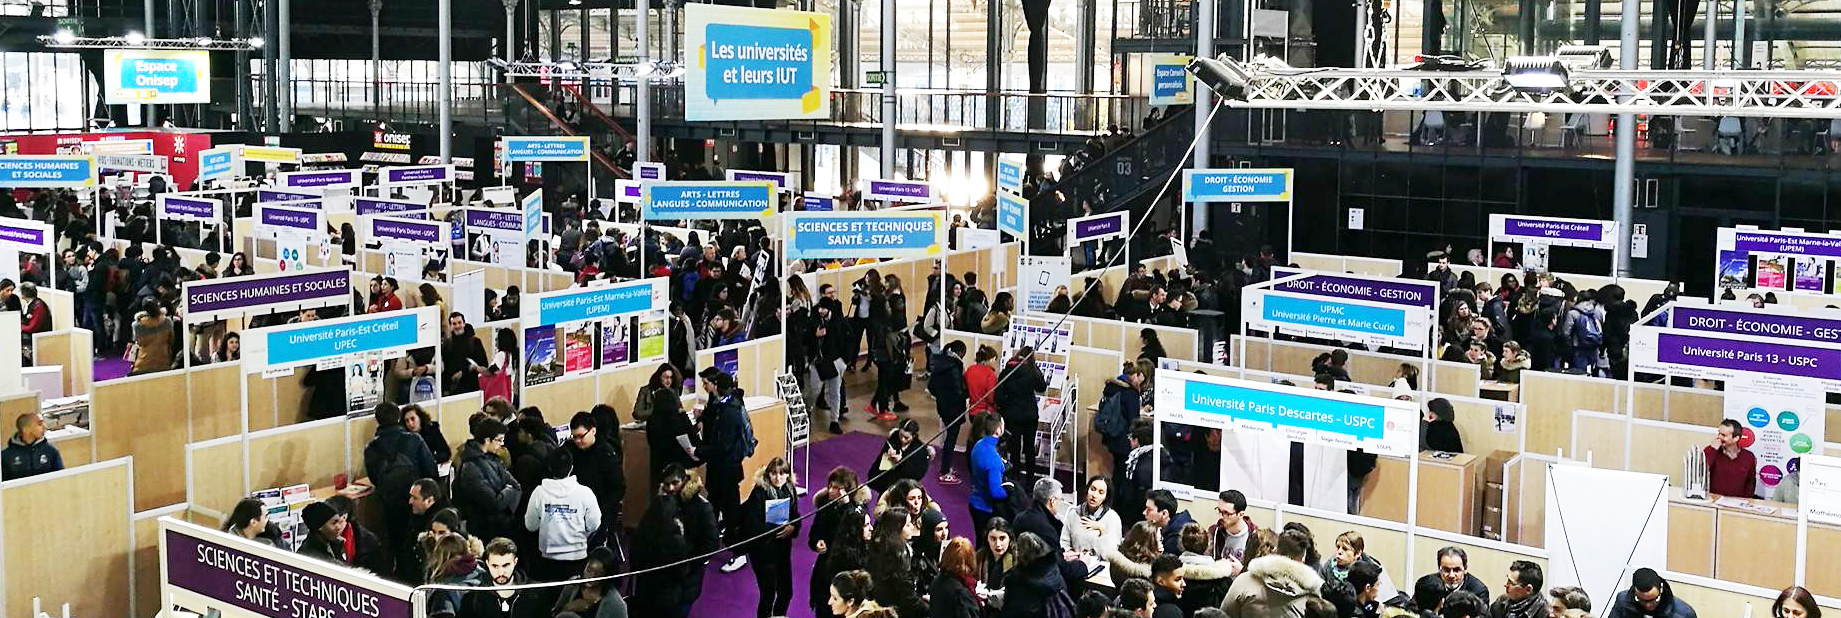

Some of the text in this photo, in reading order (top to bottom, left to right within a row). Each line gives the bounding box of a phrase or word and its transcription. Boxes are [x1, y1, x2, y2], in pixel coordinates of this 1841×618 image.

[711, 41, 808, 62] Les universités
[135, 60, 177, 73] Espace
[723, 66, 797, 84] et leurs IUT
[136, 75, 178, 89] Onisep
[0, 162, 79, 171] CIENCES HUMAINES
[1116, 161, 1132, 176] 03
[12, 170, 63, 179] ET SOCIALES
[1204, 175, 1227, 184] DROIT
[1233, 174, 1273, 184] ÉCONOMIE
[707, 190, 740, 198] LETTRES
[1222, 184, 1255, 193] GESTION
[652, 200, 690, 208] LANGUES
[696, 200, 768, 208] COMMUNICATION
[489, 212, 502, 220] ARTS
[473, 218, 522, 230] LANGUES COMMUN
[797, 221, 933, 233] SCIENCES ET TECHNIQUES
[1517, 221, 1546, 229] Université
[827, 233, 862, 245] SANTÉ
[871, 234, 904, 244] STAPS
[1736, 234, 1769, 243] Université
[1769, 237, 1798, 245] Paris-Est
[1780, 244, 1805, 253] (UPEM)
[191, 278, 347, 306] SCIENCES HUMAINES ET SOCIALES
[1286, 279, 1314, 291] DROIT
[1321, 280, 1372, 297] ÉCONOMIE
[1379, 289, 1422, 301] GESTION
[541, 288, 653, 311] Université Paris-Est Marne-la-Vallée
[586, 304, 610, 316] (UPEM)
[1320, 304, 1345, 316] UPMC
[1271, 309, 1311, 322] Université
[1312, 314, 1336, 325] Pierre
[1337, 317, 1346, 325] et
[1347, 318, 1371, 329] Marie
[1372, 321, 1395, 332] Curie
[1689, 316, 1726, 329] DROIT
[1736, 318, 1803, 336] ÉCONOMIE
[289, 320, 399, 345] Université Paris-Est Créteil
[334, 338, 357, 350] UPEC
[1683, 344, 1735, 360] Université
[1736, 351, 1763, 363] Paris
[1766, 353, 1779, 364] 13
[1788, 356, 1818, 368] USPC
[1191, 393, 1246, 412] Université
[1248, 401, 1276, 416] Paris
[1278, 405, 1334, 424] Descartes
[1343, 413, 1375, 429] USPC
[197, 543, 380, 618] SCIENCES ET TECHNIQUES
[235, 580, 279, 613] SANTÉ
[291, 598, 336, 618] STAPS
